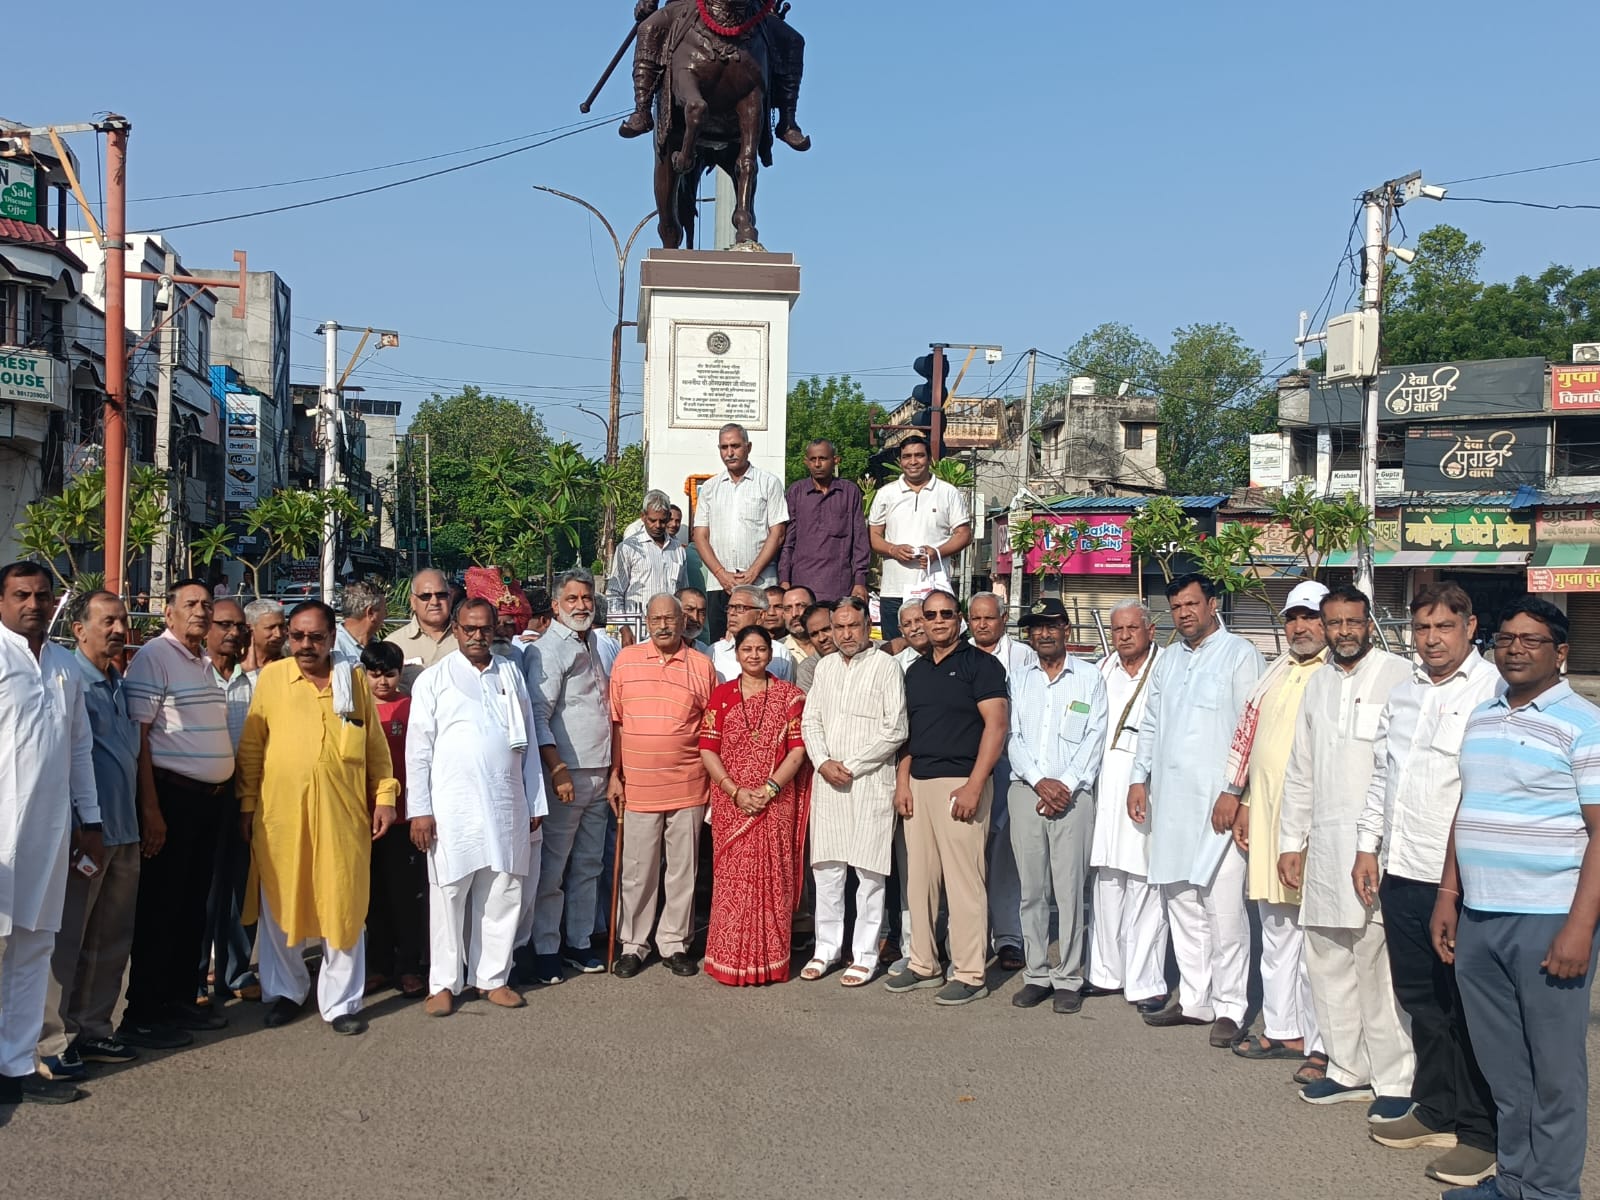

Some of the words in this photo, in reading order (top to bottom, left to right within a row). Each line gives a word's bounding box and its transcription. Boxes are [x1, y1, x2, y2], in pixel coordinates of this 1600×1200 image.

[11, 185, 33, 199] Sale
[0, 356, 38, 371] REST
[0, 372, 45, 388] OUSE
[1409, 372, 1429, 385] देवा
[1557, 371, 1599, 388] गुप्ता
[1413, 402, 1440, 412] वाला
[1468, 467, 1495, 478] वाला
[1554, 573, 1584, 589] गुप्ता
